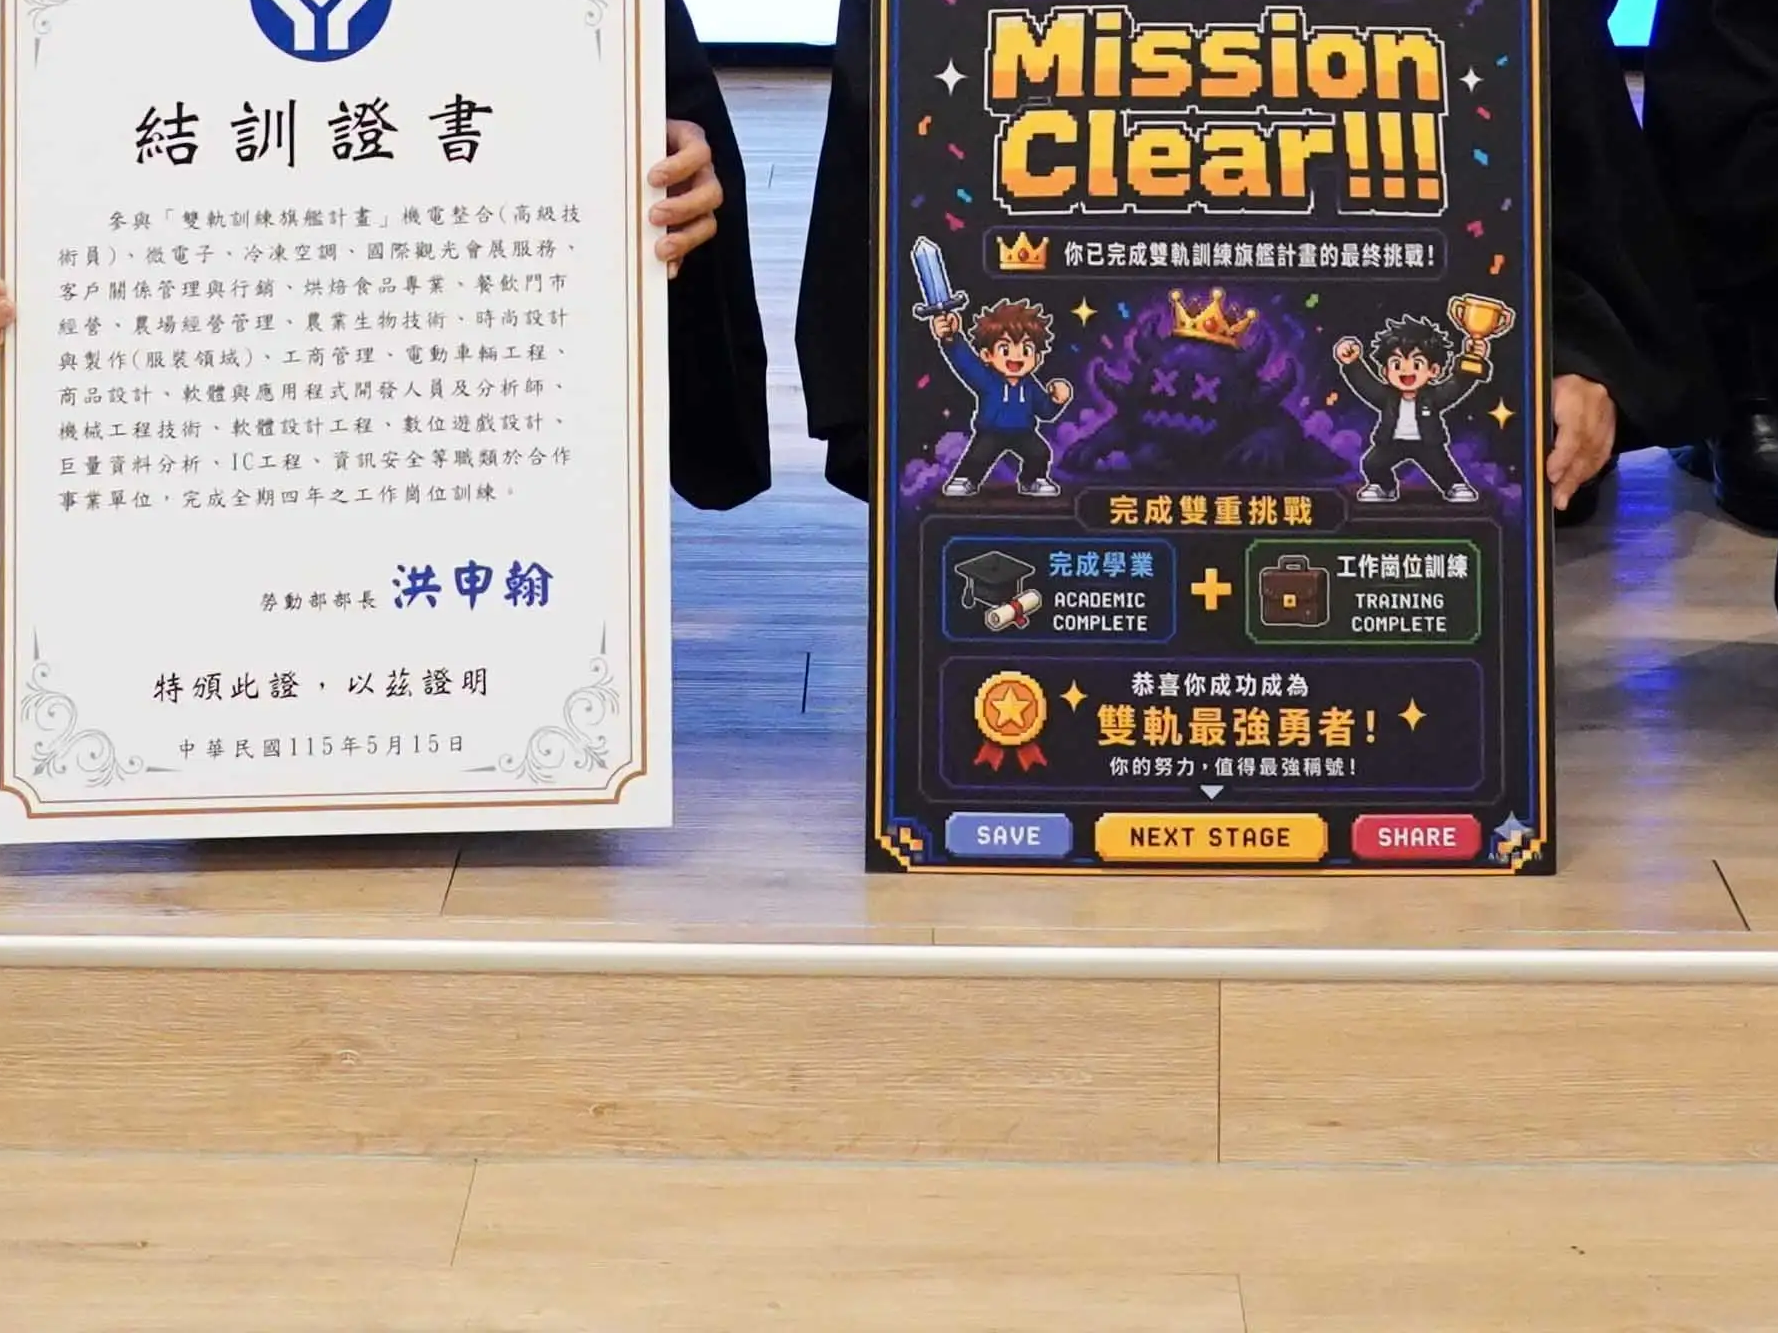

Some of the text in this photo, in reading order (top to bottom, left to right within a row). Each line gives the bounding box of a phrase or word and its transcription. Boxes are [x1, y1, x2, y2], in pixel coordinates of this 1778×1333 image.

[990, 10, 1443, 101] Mission
[135, 93, 494, 169] 結訓證書
[998, 110, 1443, 200] Clear!!!
[1109, 494, 1313, 526] 完成雙重挑戰
[1049, 550, 1154, 578] 完成學業
[1336, 553, 1468, 579] 工作崗位訓練
[391, 559, 554, 611] 洪申翰
[260, 589, 377, 613] 勞動部部長
[1054, 591, 1146, 609] ACADEMIC
[1355, 592, 1445, 610] TRAINING
[1052, 614, 1148, 632] COMPLETE
[1351, 615, 1447, 633] COMPLETE
[153, 667, 487, 704] 特頒此證，以茲證明
[1131, 671, 1309, 697] 恭喜你成功成為
[1097, 703, 1375, 747] 雙軌最強勇者！
[179, 733, 463, 760] 中華民國115年5月15日
[977, 824, 1457, 848] SAVE NEXT STAGE SHARE
